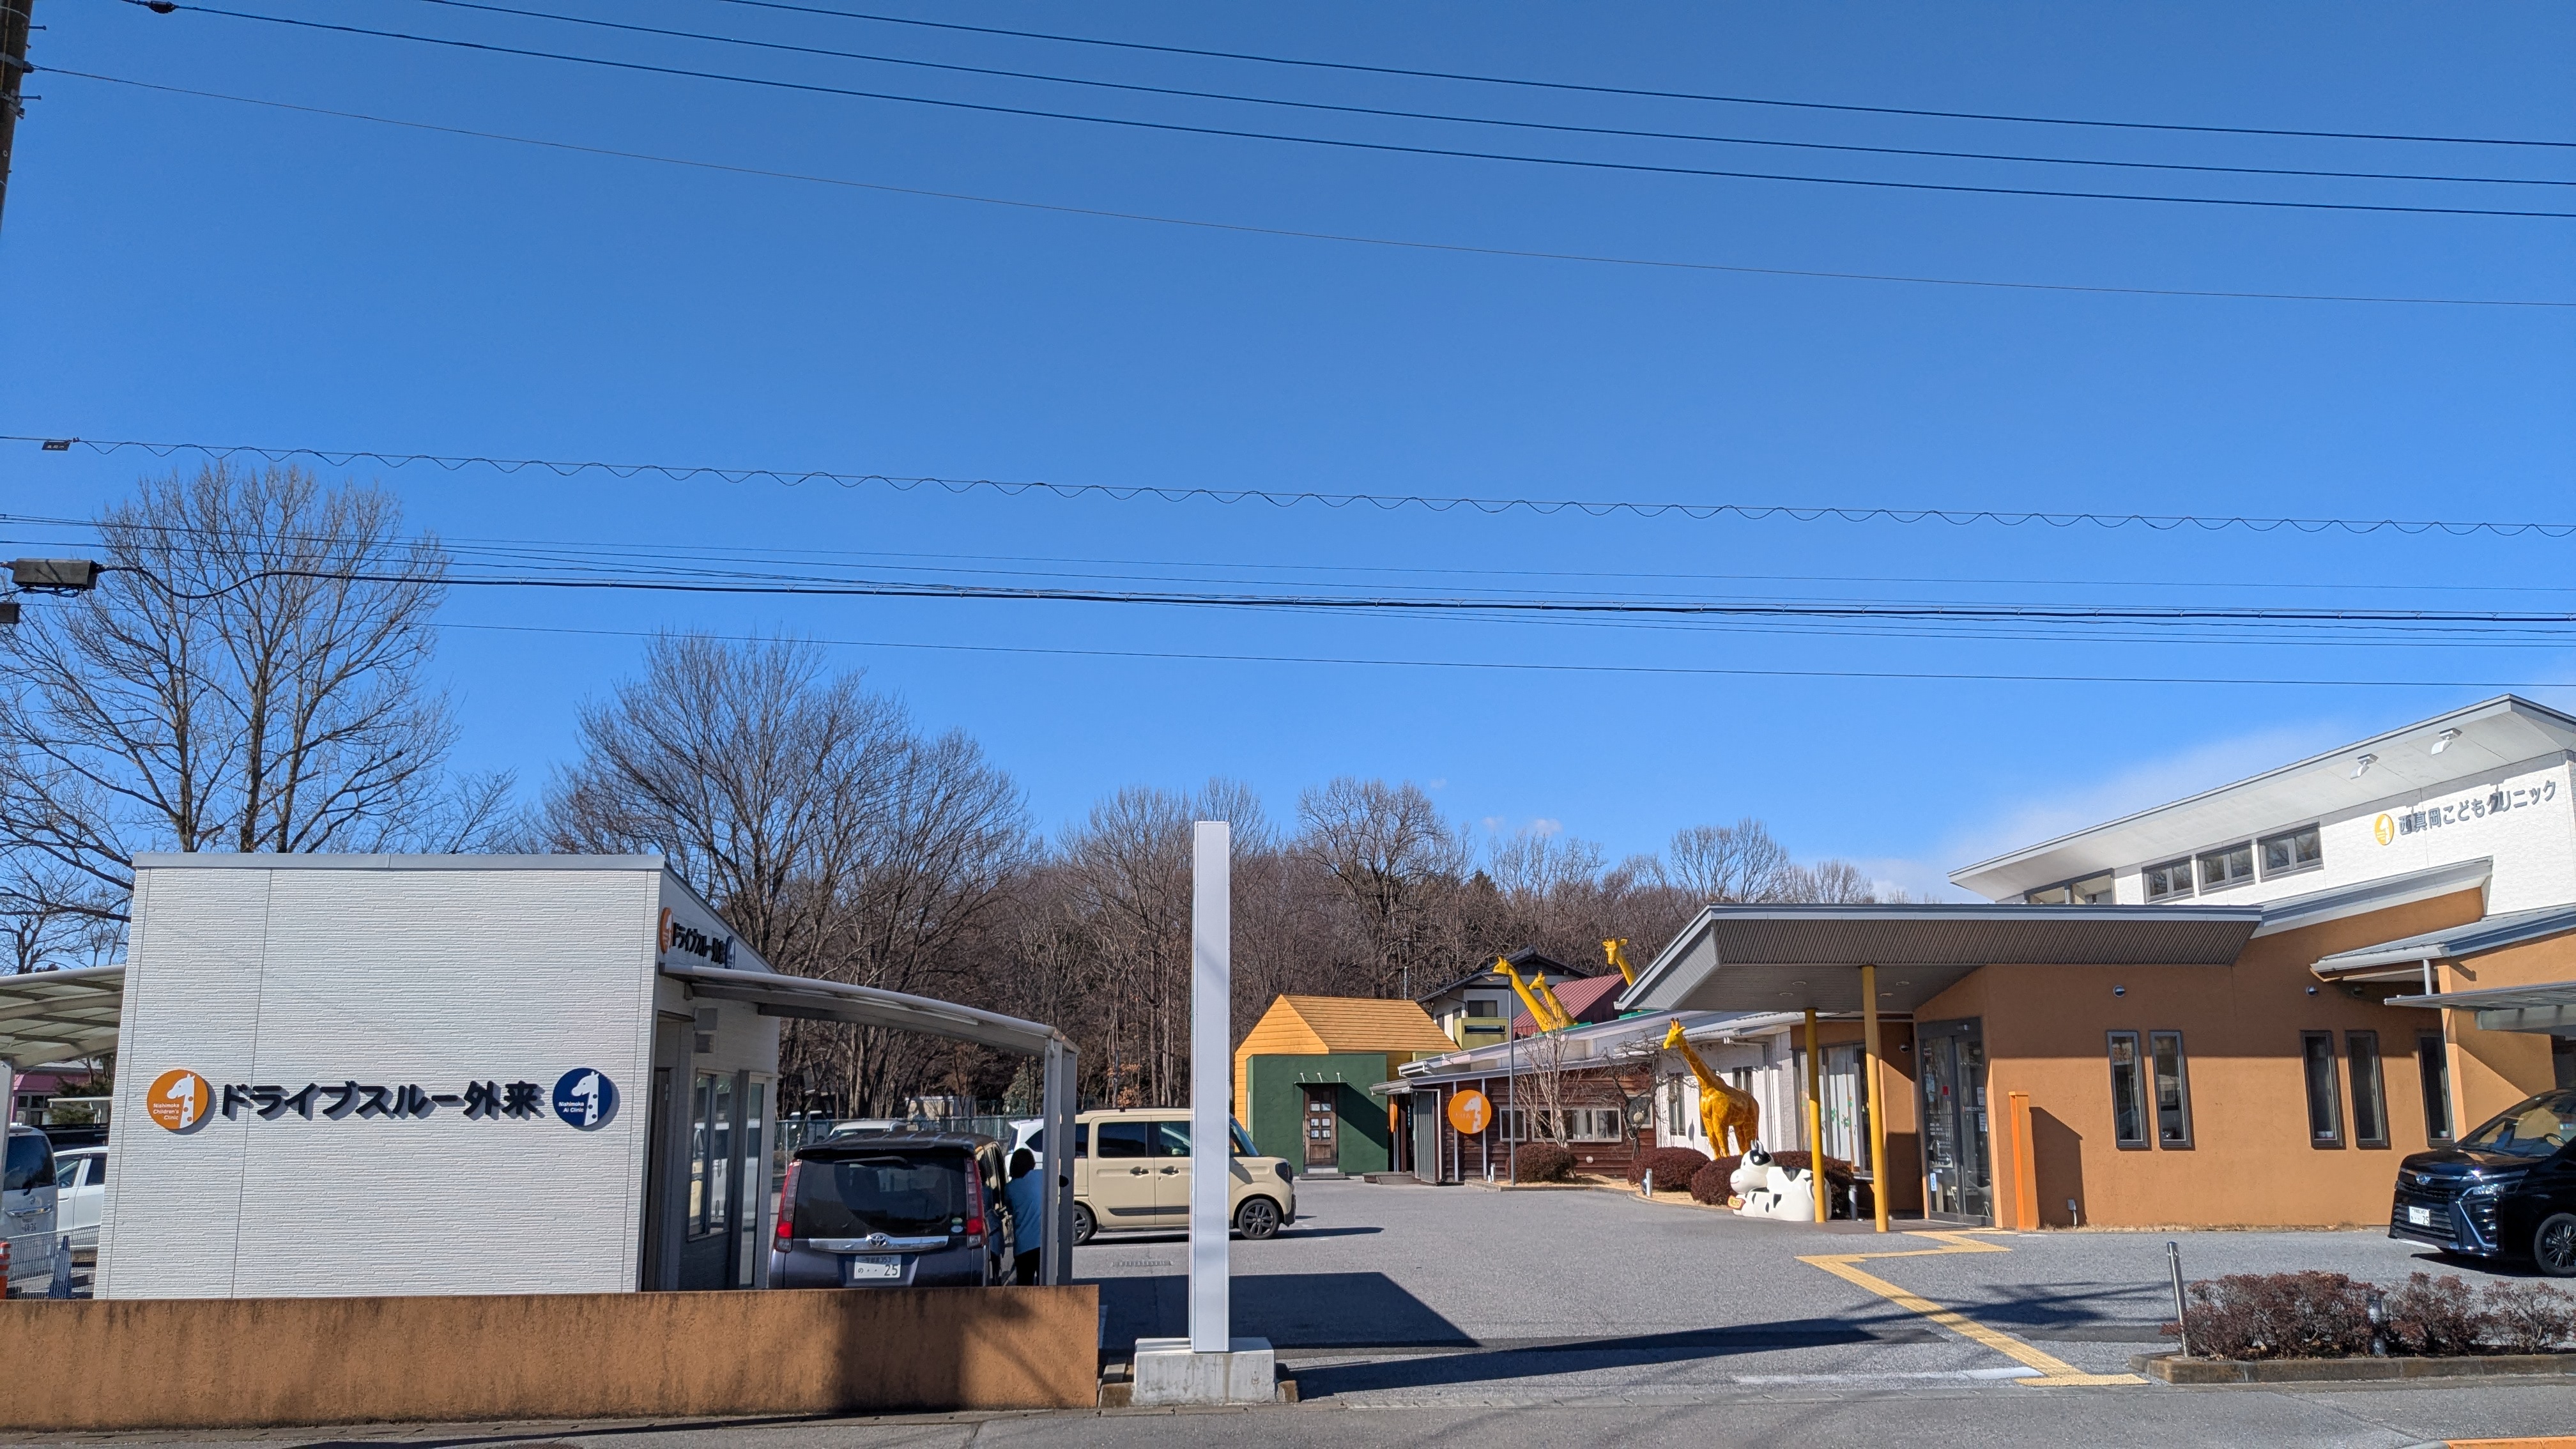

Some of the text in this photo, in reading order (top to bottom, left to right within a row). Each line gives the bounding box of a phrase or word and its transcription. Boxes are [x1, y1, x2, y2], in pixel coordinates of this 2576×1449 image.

[2398, 780, 2556, 835] 西真岡こどもクリニック
[222, 1080, 539, 1116] ドライブスルー外来
